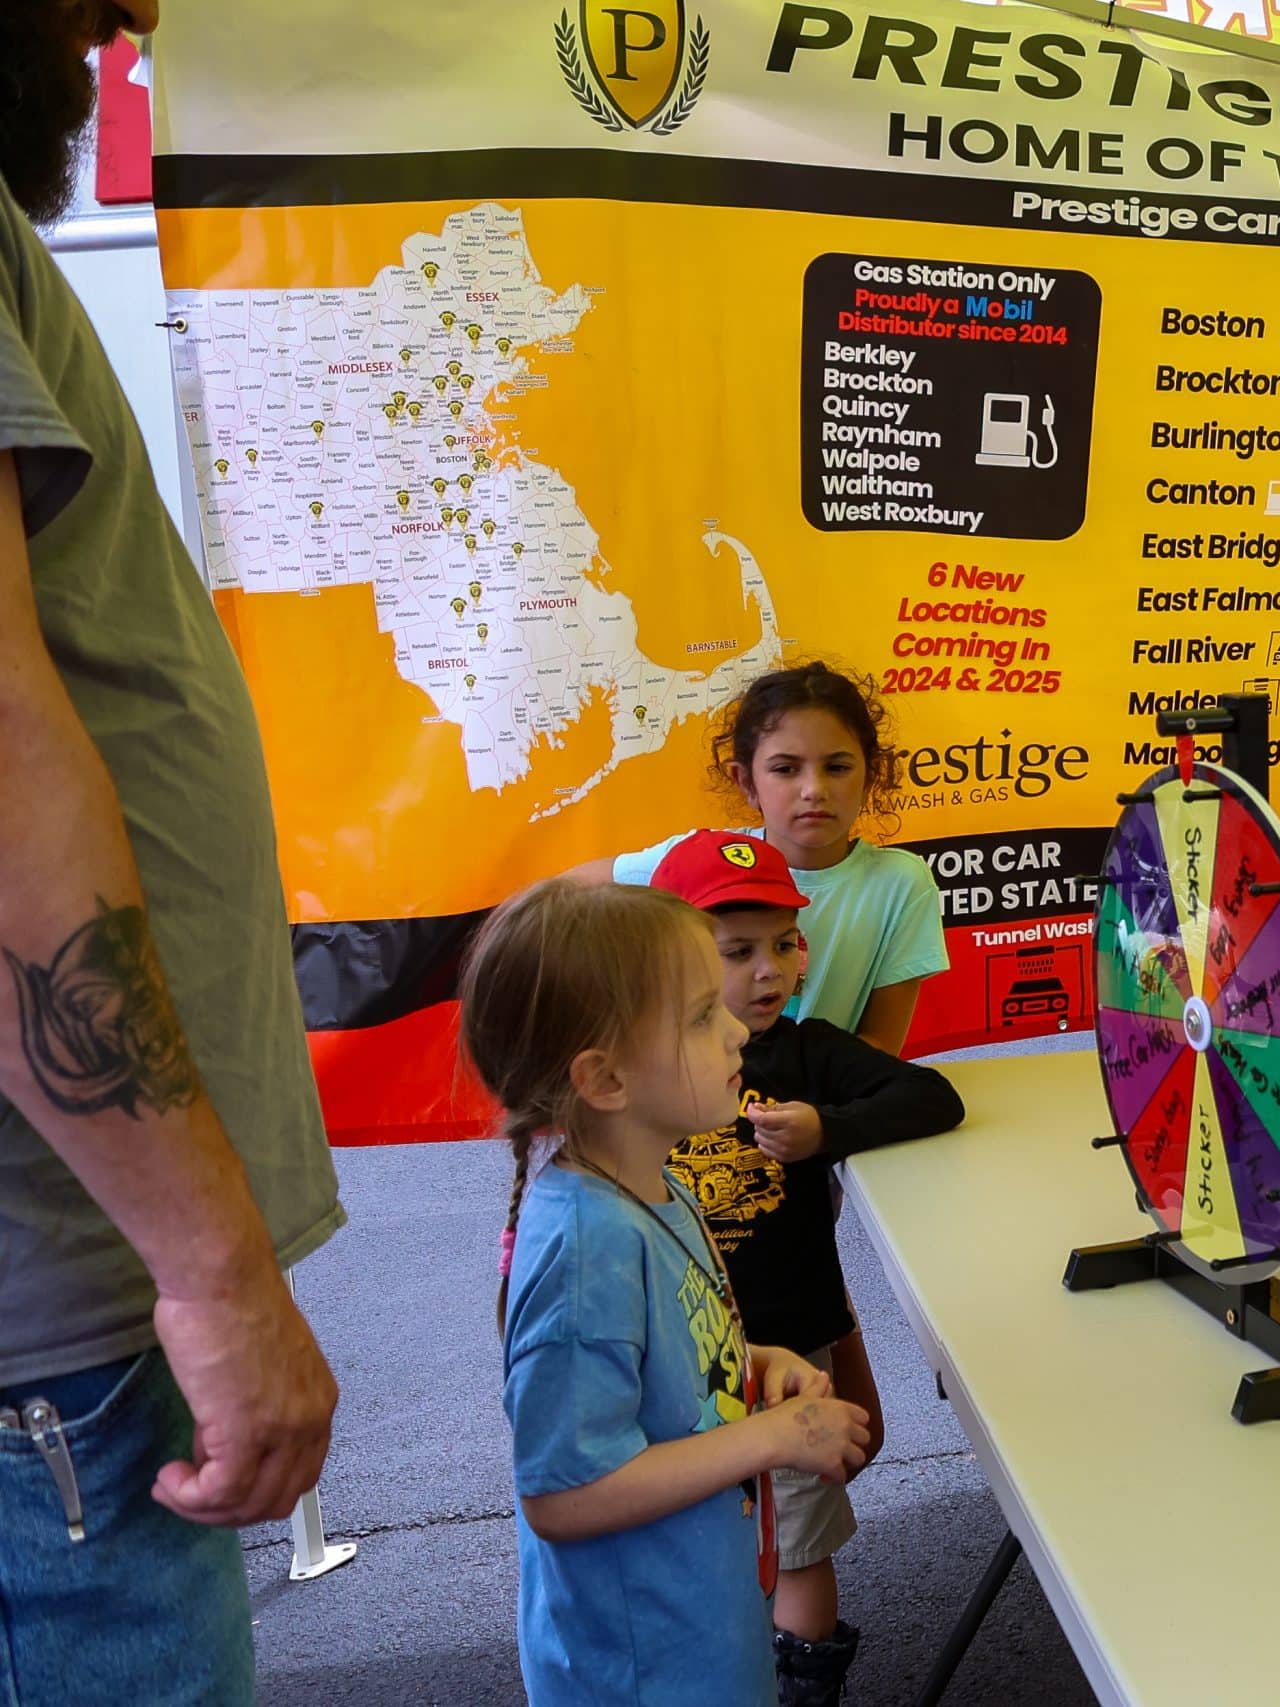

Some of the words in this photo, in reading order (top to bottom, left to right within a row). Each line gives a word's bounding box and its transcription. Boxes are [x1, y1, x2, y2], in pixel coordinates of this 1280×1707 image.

[601, 9, 666, 81] P
[888, 112, 1124, 175] HOME
[1144, 138, 1246, 184] OF
[1012, 191, 1198, 237] Prestige
[854, 261, 903, 284] Gas
[907, 265, 994, 291] Station
[999, 271, 1056, 300] Only
[466, 292, 500, 302] ESSEX
[855, 288, 940, 318] Proudly
[944, 298, 959, 314] a
[966, 295, 1033, 320] Mobil
[838, 311, 955, 337] Distributor
[958, 320, 1016, 342] since
[1020, 324, 1067, 345] 2014
[1161, 308, 1265, 339] Boston
[327, 361, 394, 375] MIDDLESEX
[824, 341, 916, 373] Berkley
[824, 368, 933, 395] Brockton
[822, 395, 909, 424] Quincy
[454, 436, 491, 446] UFFOLK
[822, 422, 941, 448] Raynham
[436, 456, 468, 464] BOSTON
[822, 449, 920, 474] Walpole
[822, 475, 933, 499] Waltham
[1146, 478, 1255, 506] Canton
[392, 522, 445, 534] NORFOLK
[822, 502, 880, 522] West
[885, 504, 984, 532] Roxbury
[1142, 533, 1203, 560] East
[928, 562, 948, 587] 6
[952, 564, 1024, 592] New
[520, 598, 577, 610] PLYMOUTH
[898, 598, 1047, 628] Locations
[1137, 587, 1198, 613] East
[687, 640, 737, 653] BARNSTABLE
[892, 632, 1016, 667] Coming
[1020, 638, 1050, 660] In
[1132, 638, 1181, 664] Fall
[1186, 636, 1255, 663] River
[428, 658, 469, 670] BRISTOL
[880, 667, 951, 694] 2024
[956, 668, 980, 691] &
[986, 669, 1062, 693] 2025
[880, 728, 1088, 797] restige
[892, 790, 945, 811] WASH
[951, 790, 962, 805] &
[970, 787, 1009, 804] GAS
[992, 842, 1061, 872] CAR
[1001, 876, 1099, 909] STATE
[972, 923, 1040, 946] Tunnel
[1198, 1104, 1213, 1215] Sticker
